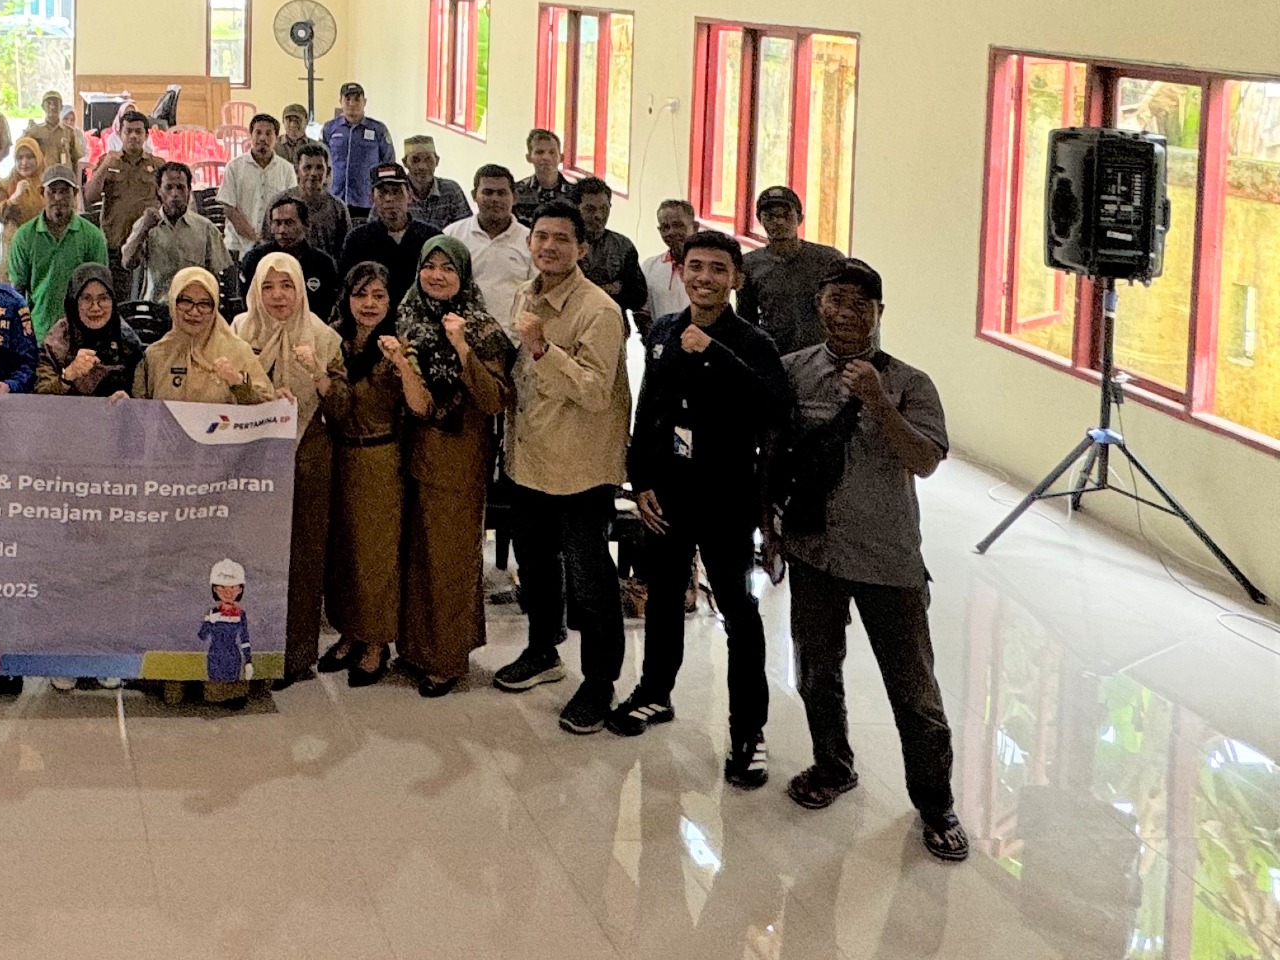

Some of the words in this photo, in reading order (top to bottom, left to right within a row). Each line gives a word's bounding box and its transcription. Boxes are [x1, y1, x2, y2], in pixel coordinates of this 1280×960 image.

[233, 416, 278, 430] PERTAMINA
[279, 415, 291, 423] EP
[18, 474, 138, 497] Peringatan
[143, 477, 275, 497] Pencemaran
[8, 502, 103, 524] Penajam
[109, 507, 169, 523] Paser
[174, 504, 229, 522] Utara
